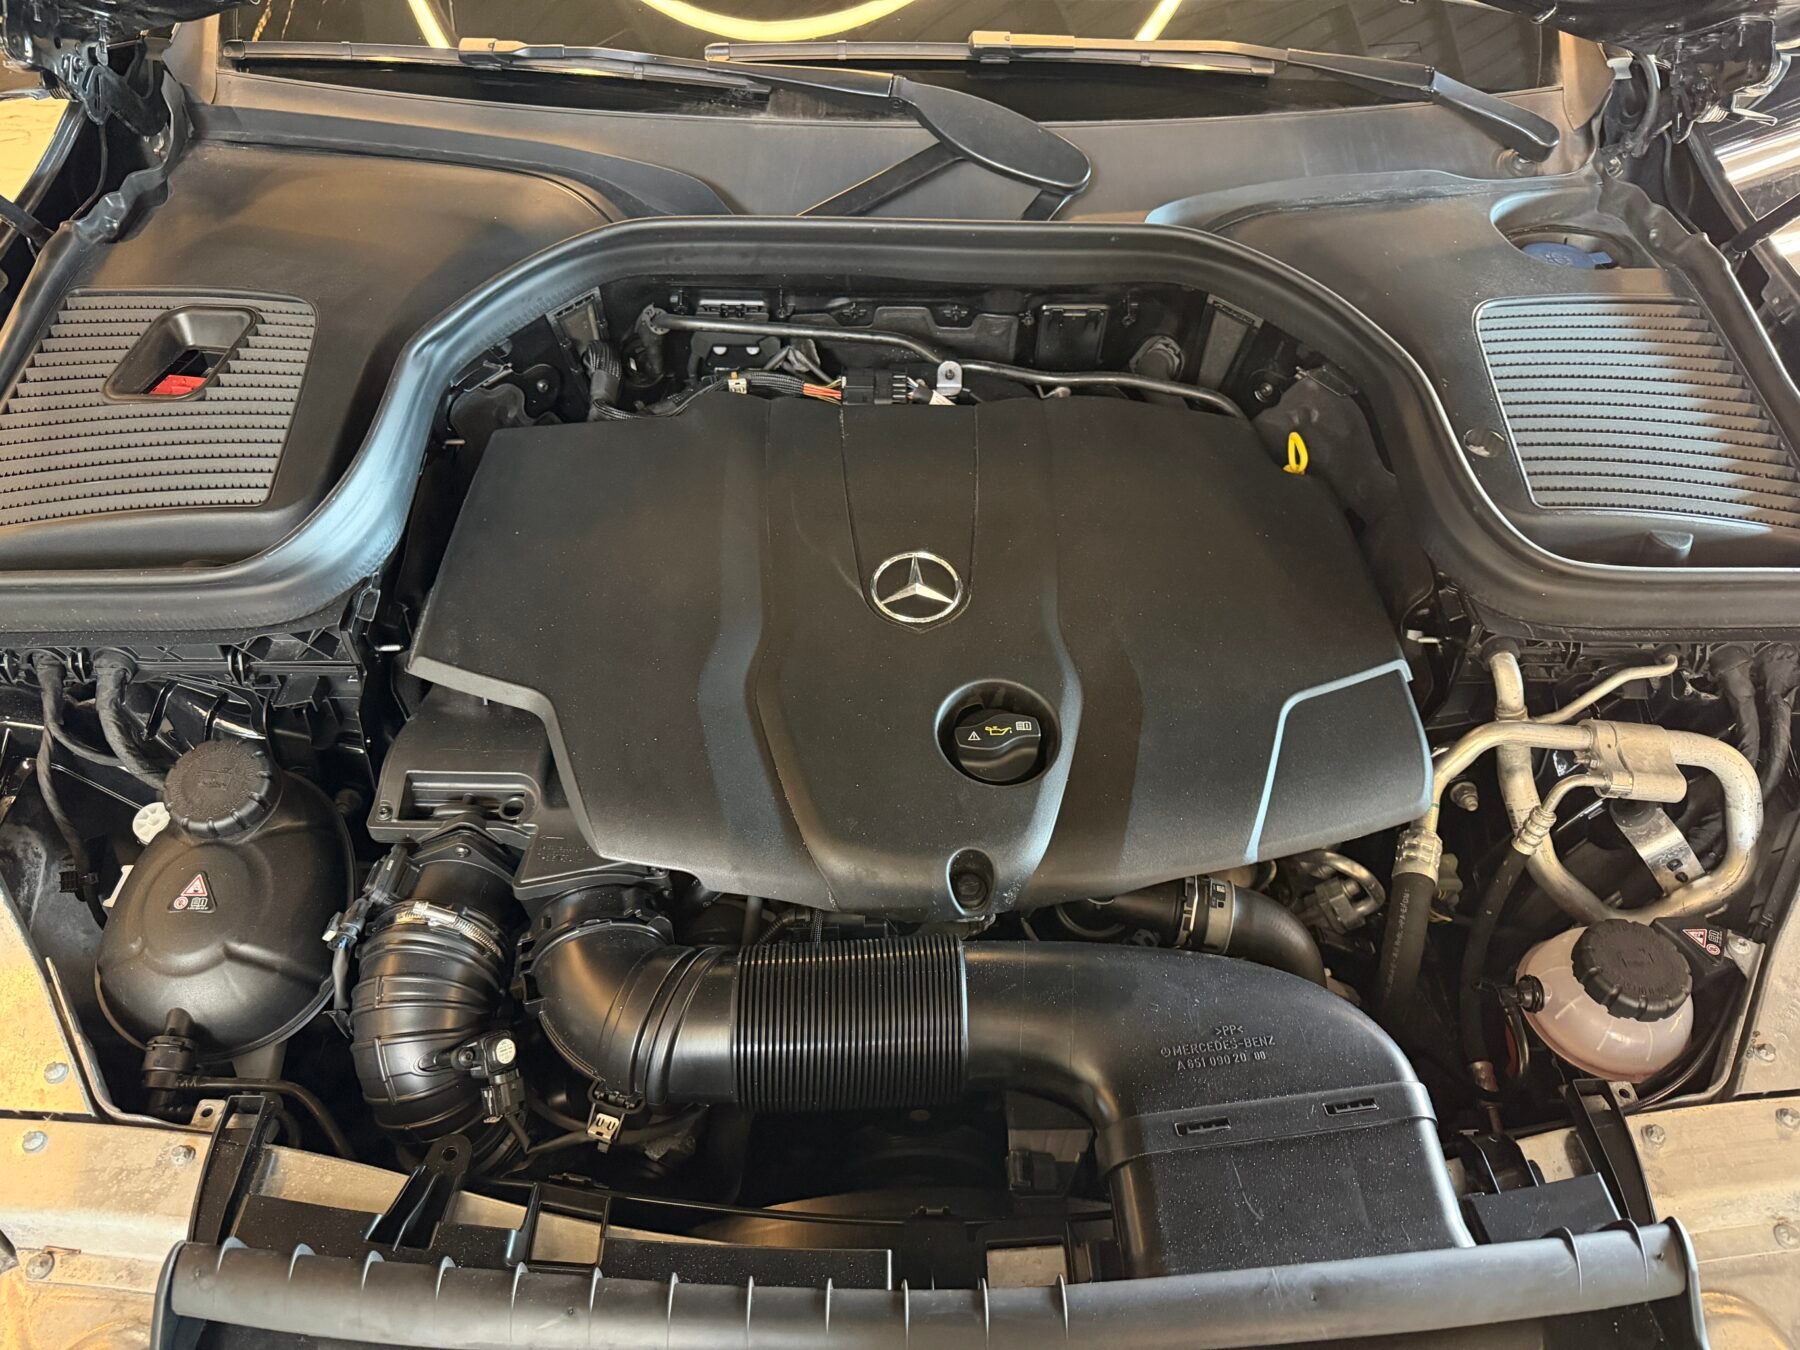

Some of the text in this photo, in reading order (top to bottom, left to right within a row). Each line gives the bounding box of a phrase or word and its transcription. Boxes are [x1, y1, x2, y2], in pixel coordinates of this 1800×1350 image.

[1172, 1035, 1276, 1056] MERCEDES-BENZ
[1177, 1060, 1186, 1071] A
[1187, 1057, 1206, 1069] 651
[1232, 1052, 1247, 1063] 20
